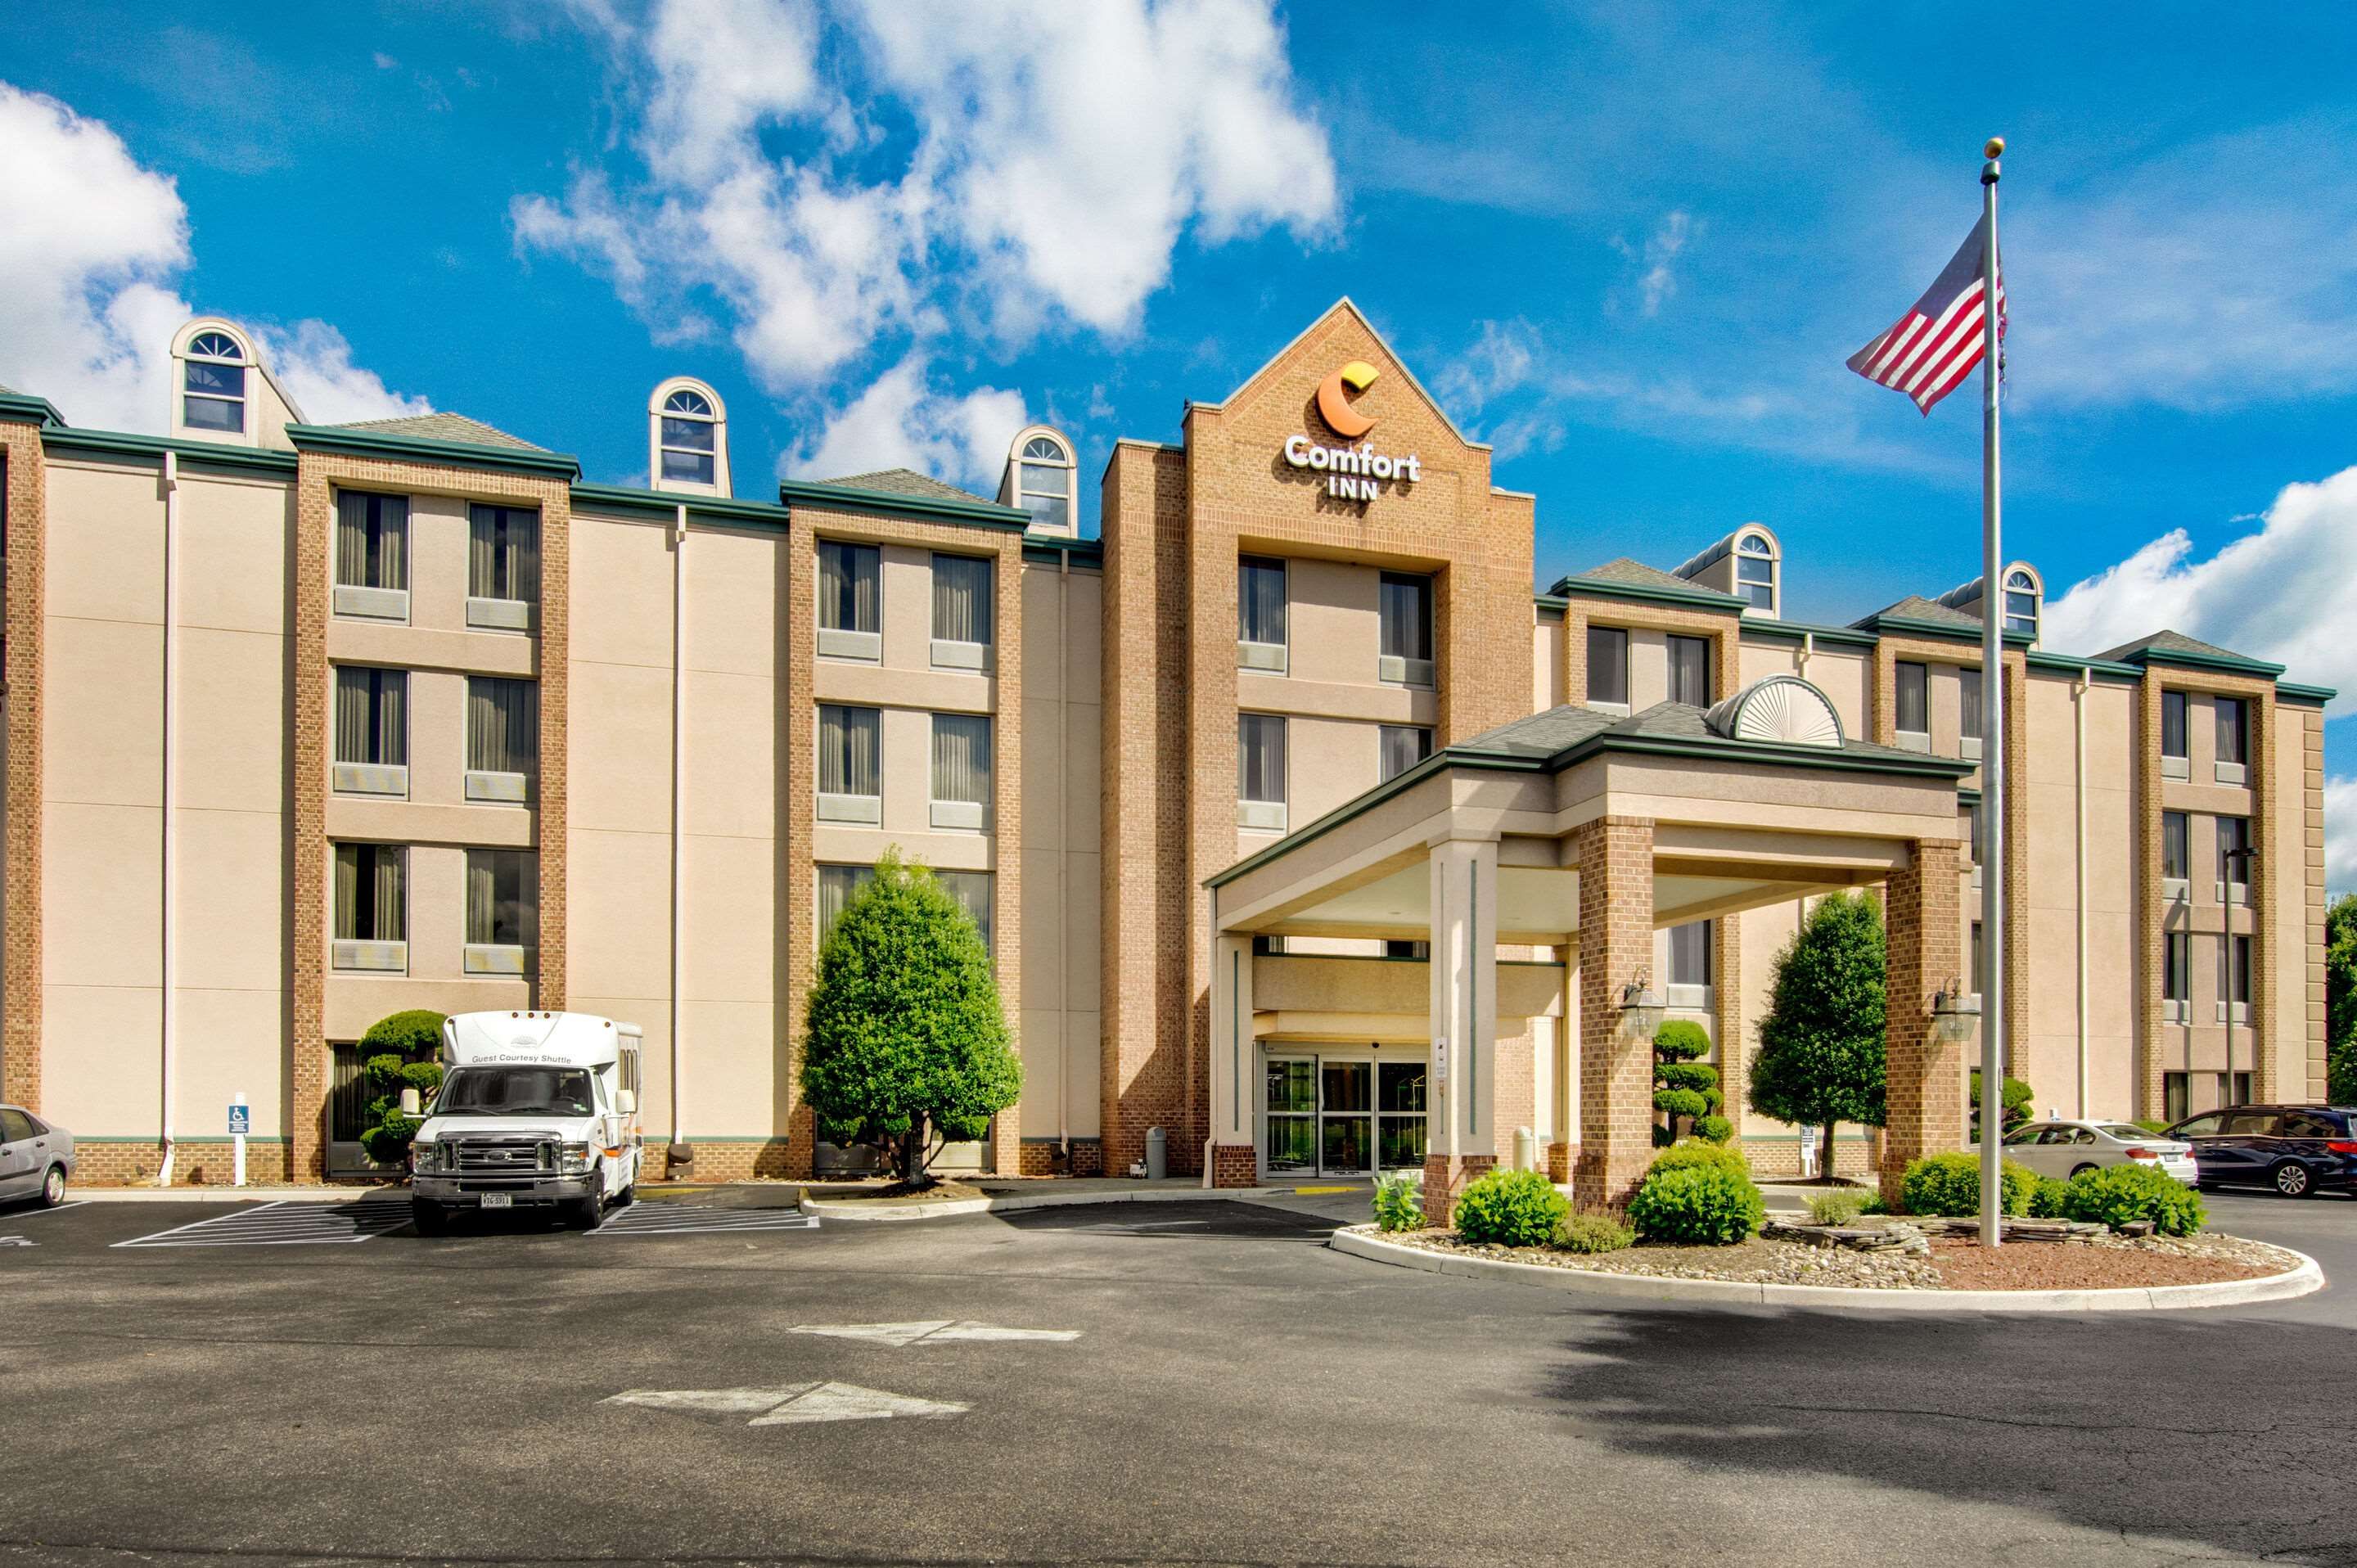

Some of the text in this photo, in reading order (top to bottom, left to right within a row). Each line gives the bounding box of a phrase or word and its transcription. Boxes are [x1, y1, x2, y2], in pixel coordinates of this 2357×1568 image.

[1284, 435, 1421, 482] Comfort
[1328, 475, 1378, 502] INN
[471, 1054, 571, 1064] Guest Courtesy Shuttle
